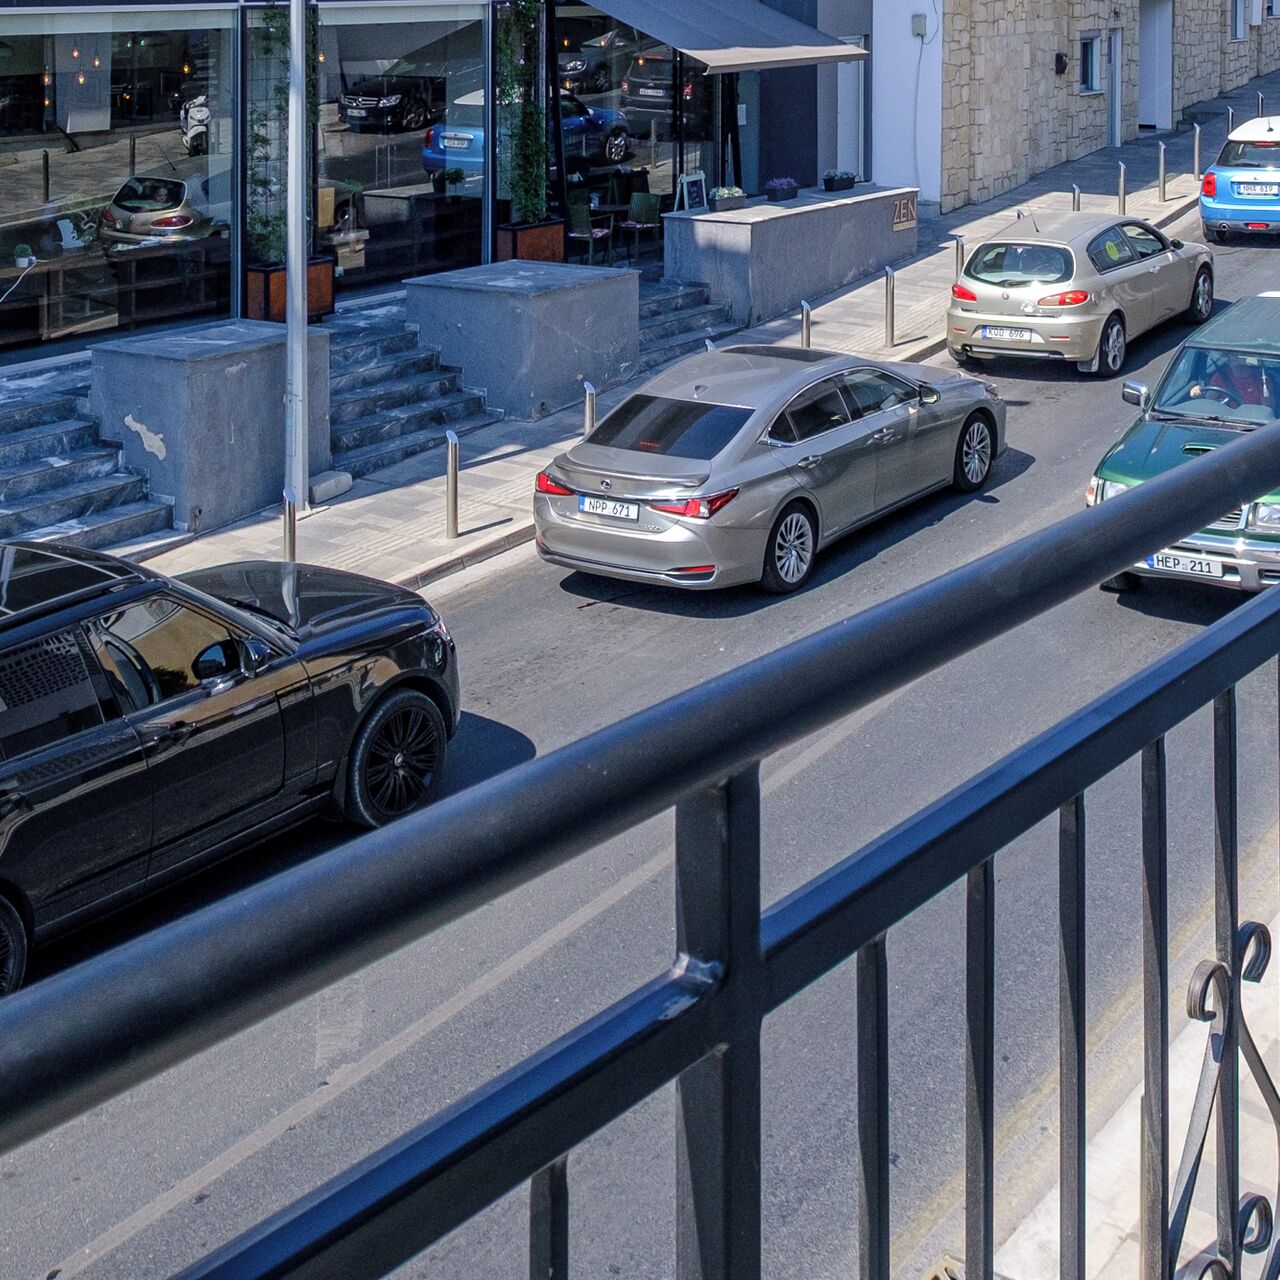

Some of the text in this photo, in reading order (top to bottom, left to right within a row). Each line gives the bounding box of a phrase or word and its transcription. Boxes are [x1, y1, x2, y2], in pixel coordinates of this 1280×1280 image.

[893, 198, 917, 223] ZEN
[1009, 328, 1024, 338] 696
[589, 500, 630, 518] NPP 671
[1156, 555, 1213, 574] HEP 211
